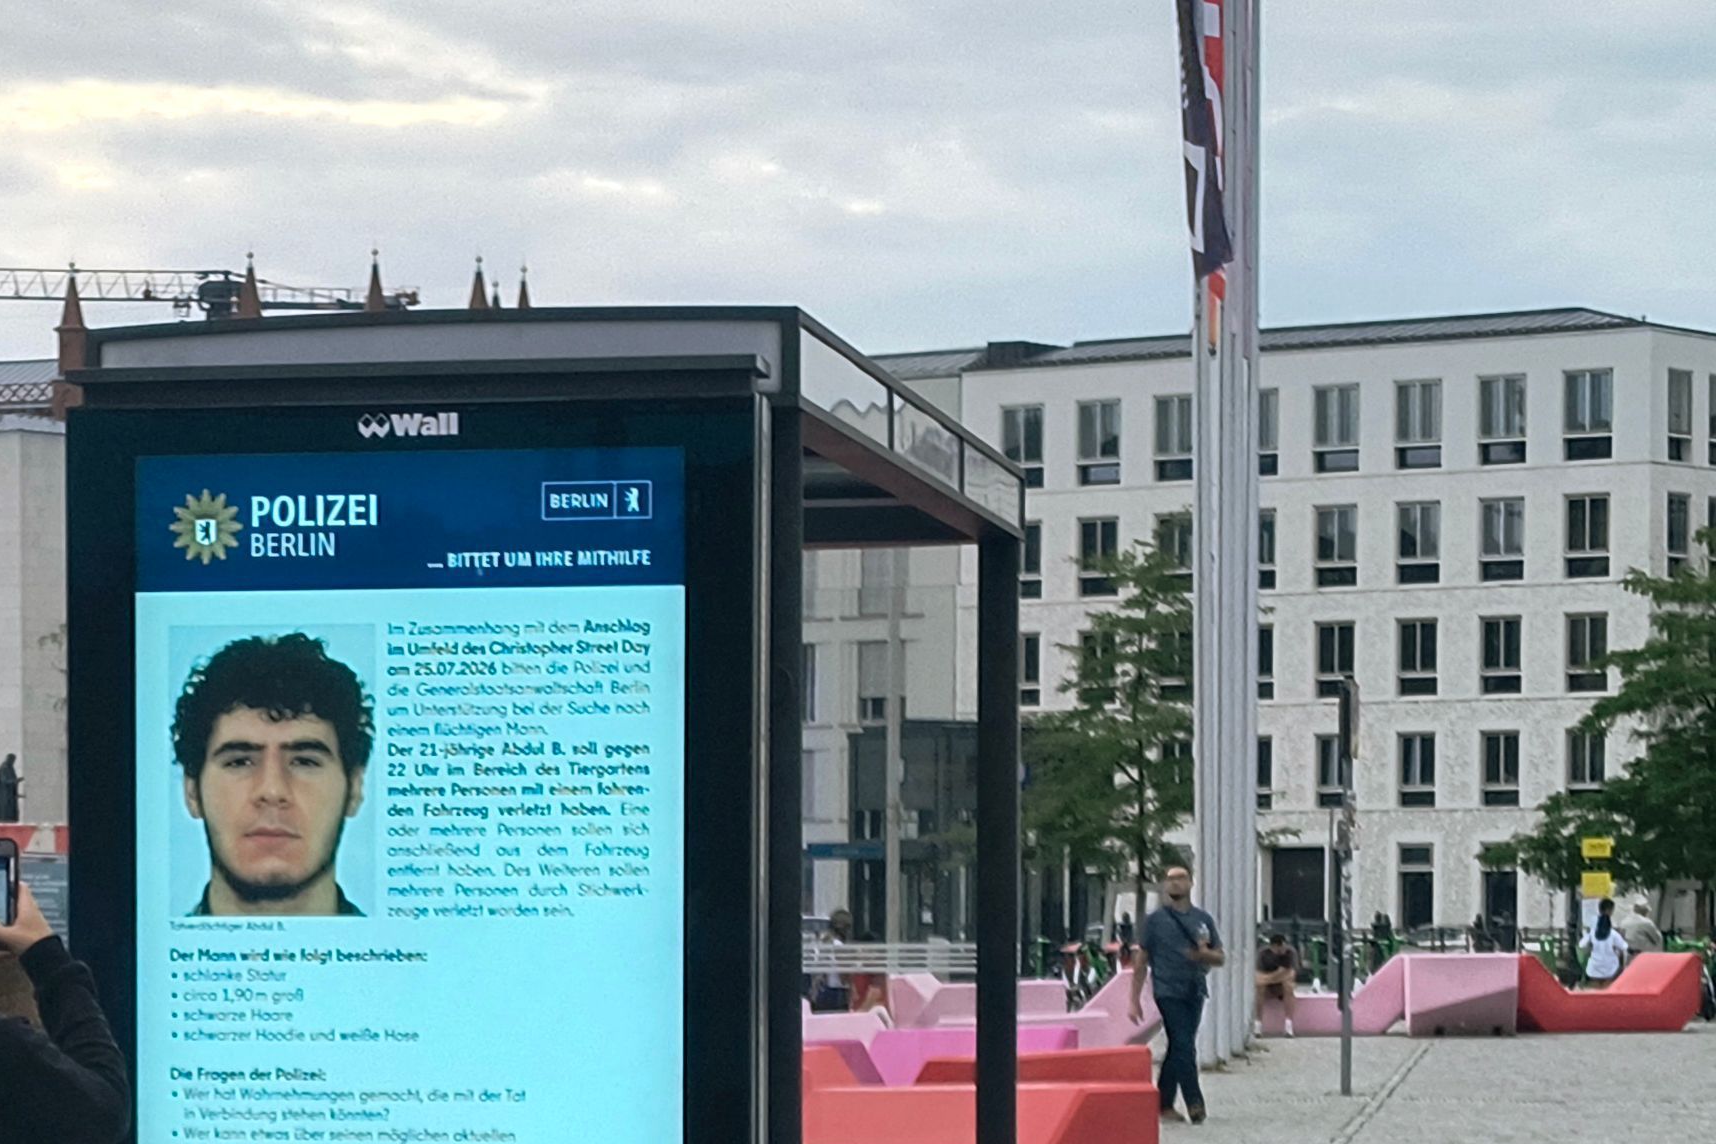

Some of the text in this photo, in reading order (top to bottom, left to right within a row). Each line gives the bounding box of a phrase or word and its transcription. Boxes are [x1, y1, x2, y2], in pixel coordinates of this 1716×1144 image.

[391, 413, 459, 436] Wall
[550, 492, 609, 509] BERLIN
[251, 494, 378, 527] POLIZEI
[250, 533, 335, 557] BERLIN
[447, 549, 652, 568] BITTET UM IHRE MITHILFE
[584, 621, 650, 638] Anschlag
[489, 642, 573, 658] Christopher
[576, 642, 618, 655] Street
[415, 662, 497, 675] 25.07.2026
[388, 742, 413, 756] Der
[502, 742, 545, 756] Abdul
[552, 742, 566, 756] B.
[604, 746, 650, 760] gegen
[388, 762, 406, 776] 22
[474, 762, 527, 776] Bereich
[568, 762, 650, 780] Tiergartens
[388, 783, 446, 796] mehrere
[451, 783, 516, 796] Personen
[387, 803, 414, 816] den
[424, 803, 488, 820] Fahrzeug
[498, 803, 552, 816] verletzt
[560, 803, 611, 816] haben.
[170, 948, 427, 966] Der Mann wird wie folgt beschrieben:
[170, 1067, 326, 1084] Die Fragen der Polizei:
